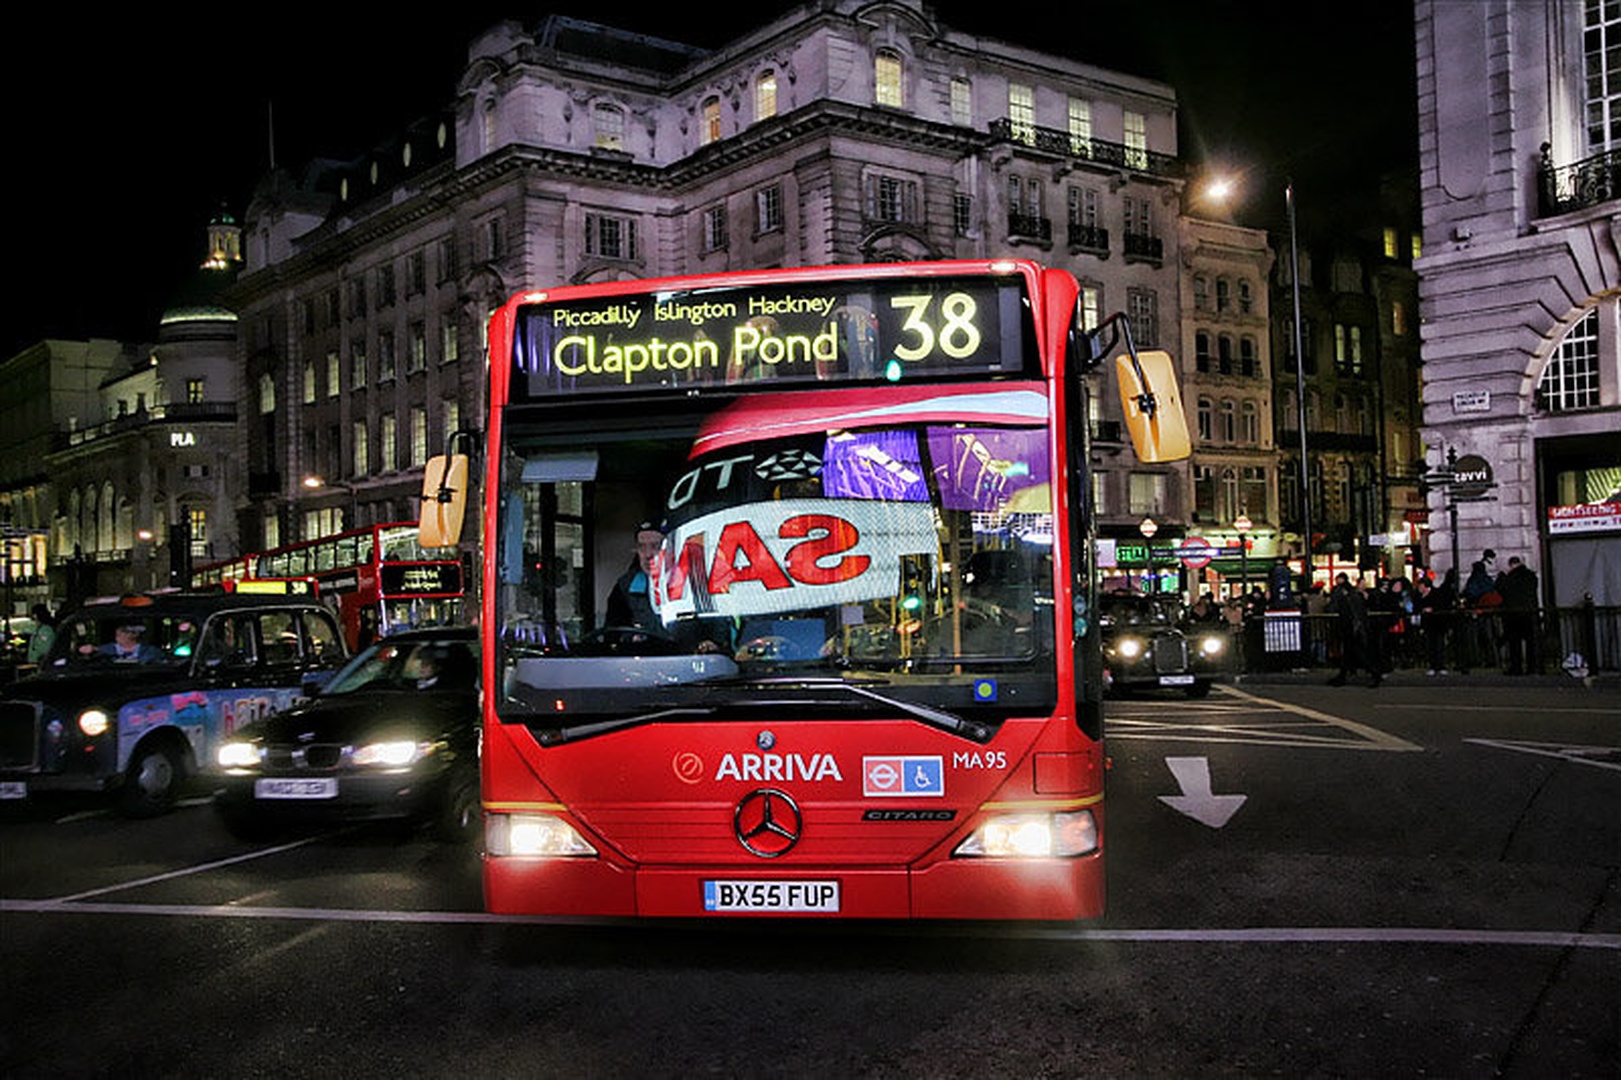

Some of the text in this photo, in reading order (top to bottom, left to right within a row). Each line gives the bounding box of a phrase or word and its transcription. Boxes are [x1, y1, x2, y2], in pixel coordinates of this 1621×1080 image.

[554, 295, 836, 328] Piccadilly Islington Hackney
[890, 292, 981, 361] 38
[553, 321, 838, 384] Clapton Pond
[715, 753, 843, 781] ARRIVA
[867, 811, 952, 820] CITARO
[719, 885, 834, 907] BX55 FUP
